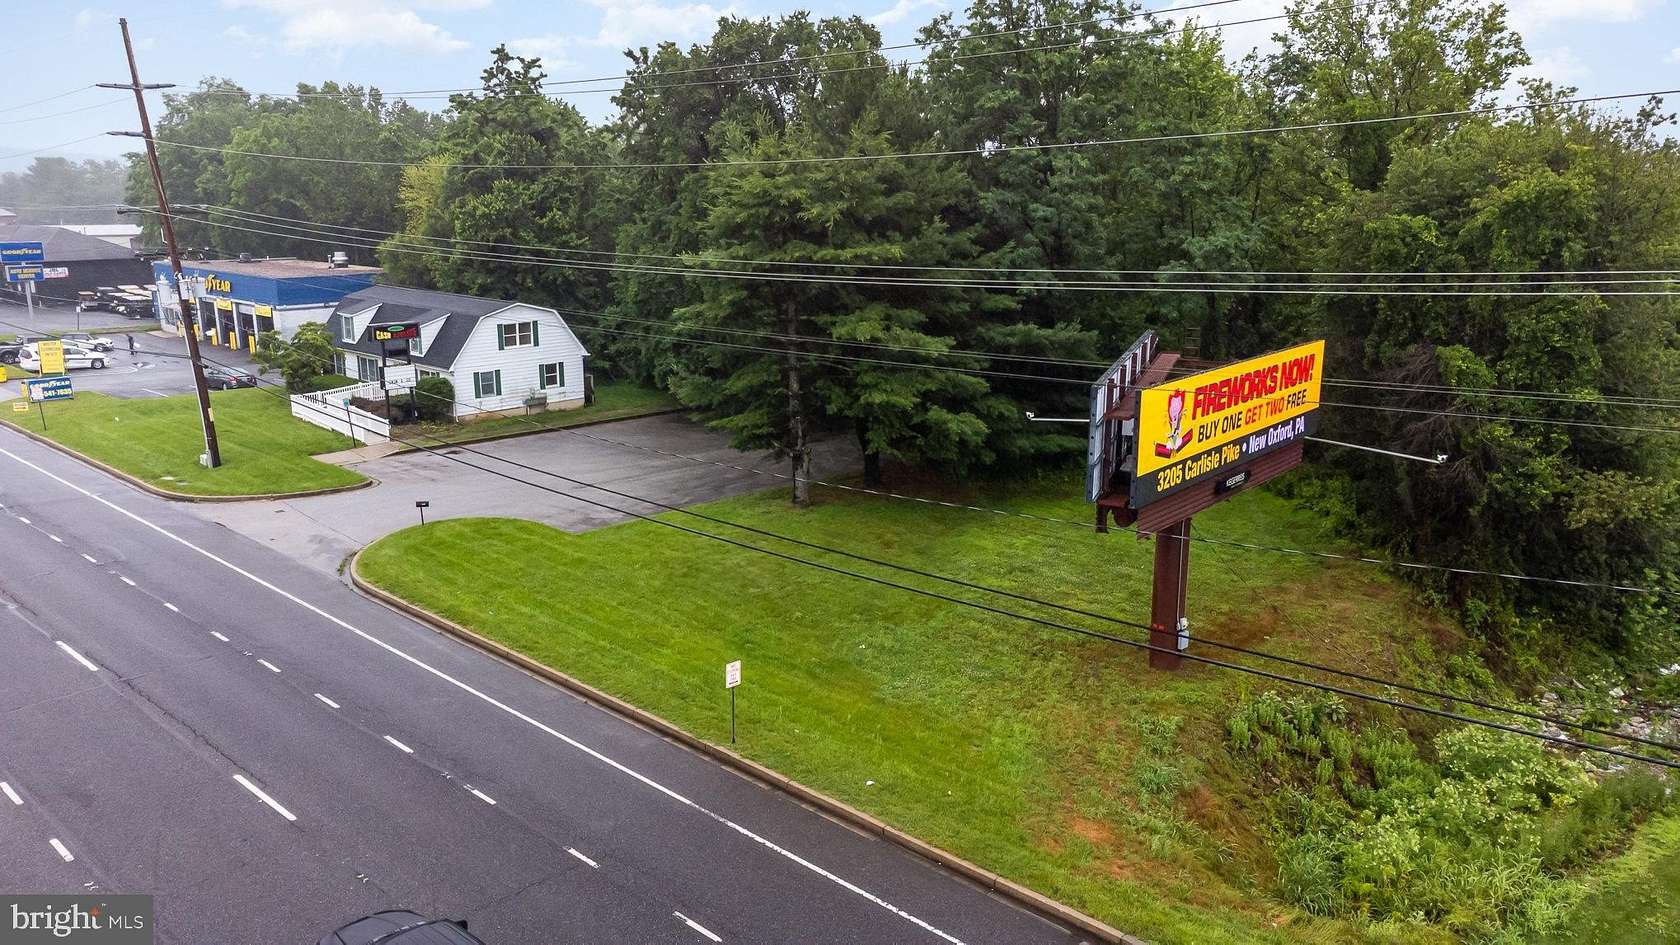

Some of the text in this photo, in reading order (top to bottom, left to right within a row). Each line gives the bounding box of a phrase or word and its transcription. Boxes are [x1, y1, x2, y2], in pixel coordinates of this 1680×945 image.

[1192, 353, 1316, 420] FIREWORKS NOW!
[1197, 389, 1308, 444] BUY ONE GET TWO FREE
[1156, 416, 1305, 492] 3205 Carlisle Pike New Oxford, PA
